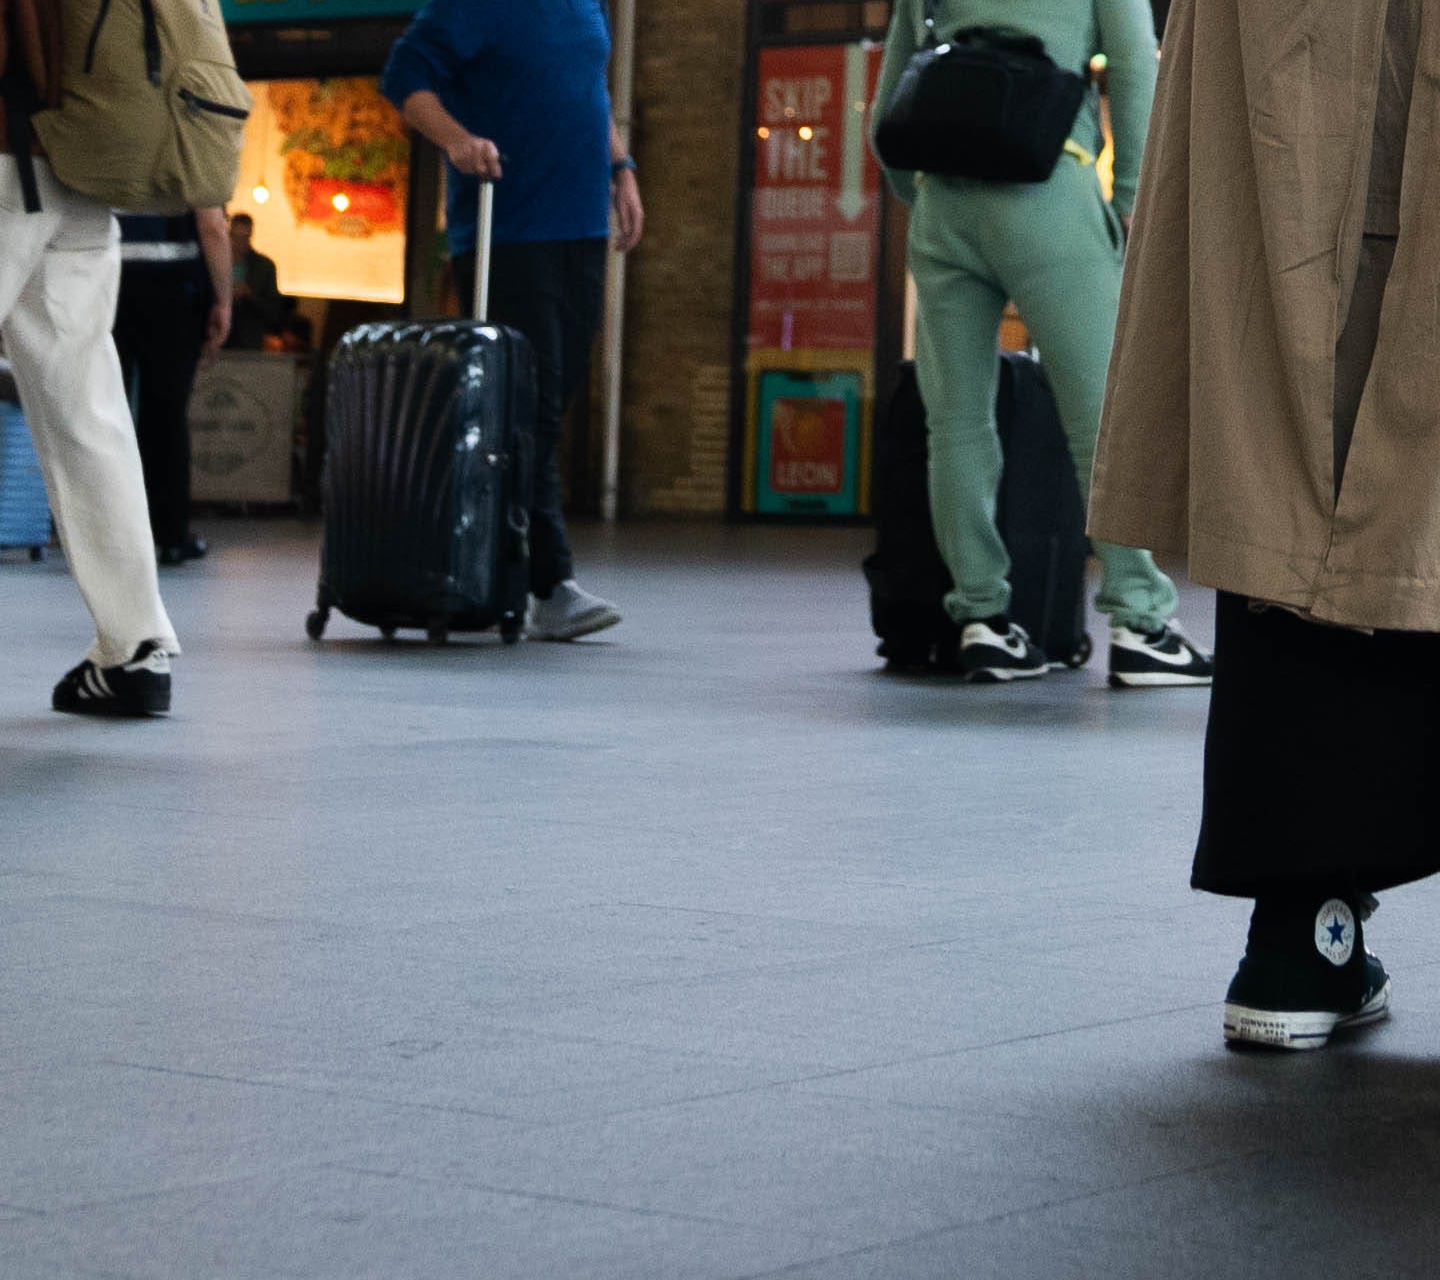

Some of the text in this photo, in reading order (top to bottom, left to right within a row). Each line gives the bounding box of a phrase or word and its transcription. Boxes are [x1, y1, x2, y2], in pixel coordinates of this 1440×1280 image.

[765, 75, 831, 123] SKIP
[765, 126, 830, 180] THE
[775, 461, 841, 489] LEON
